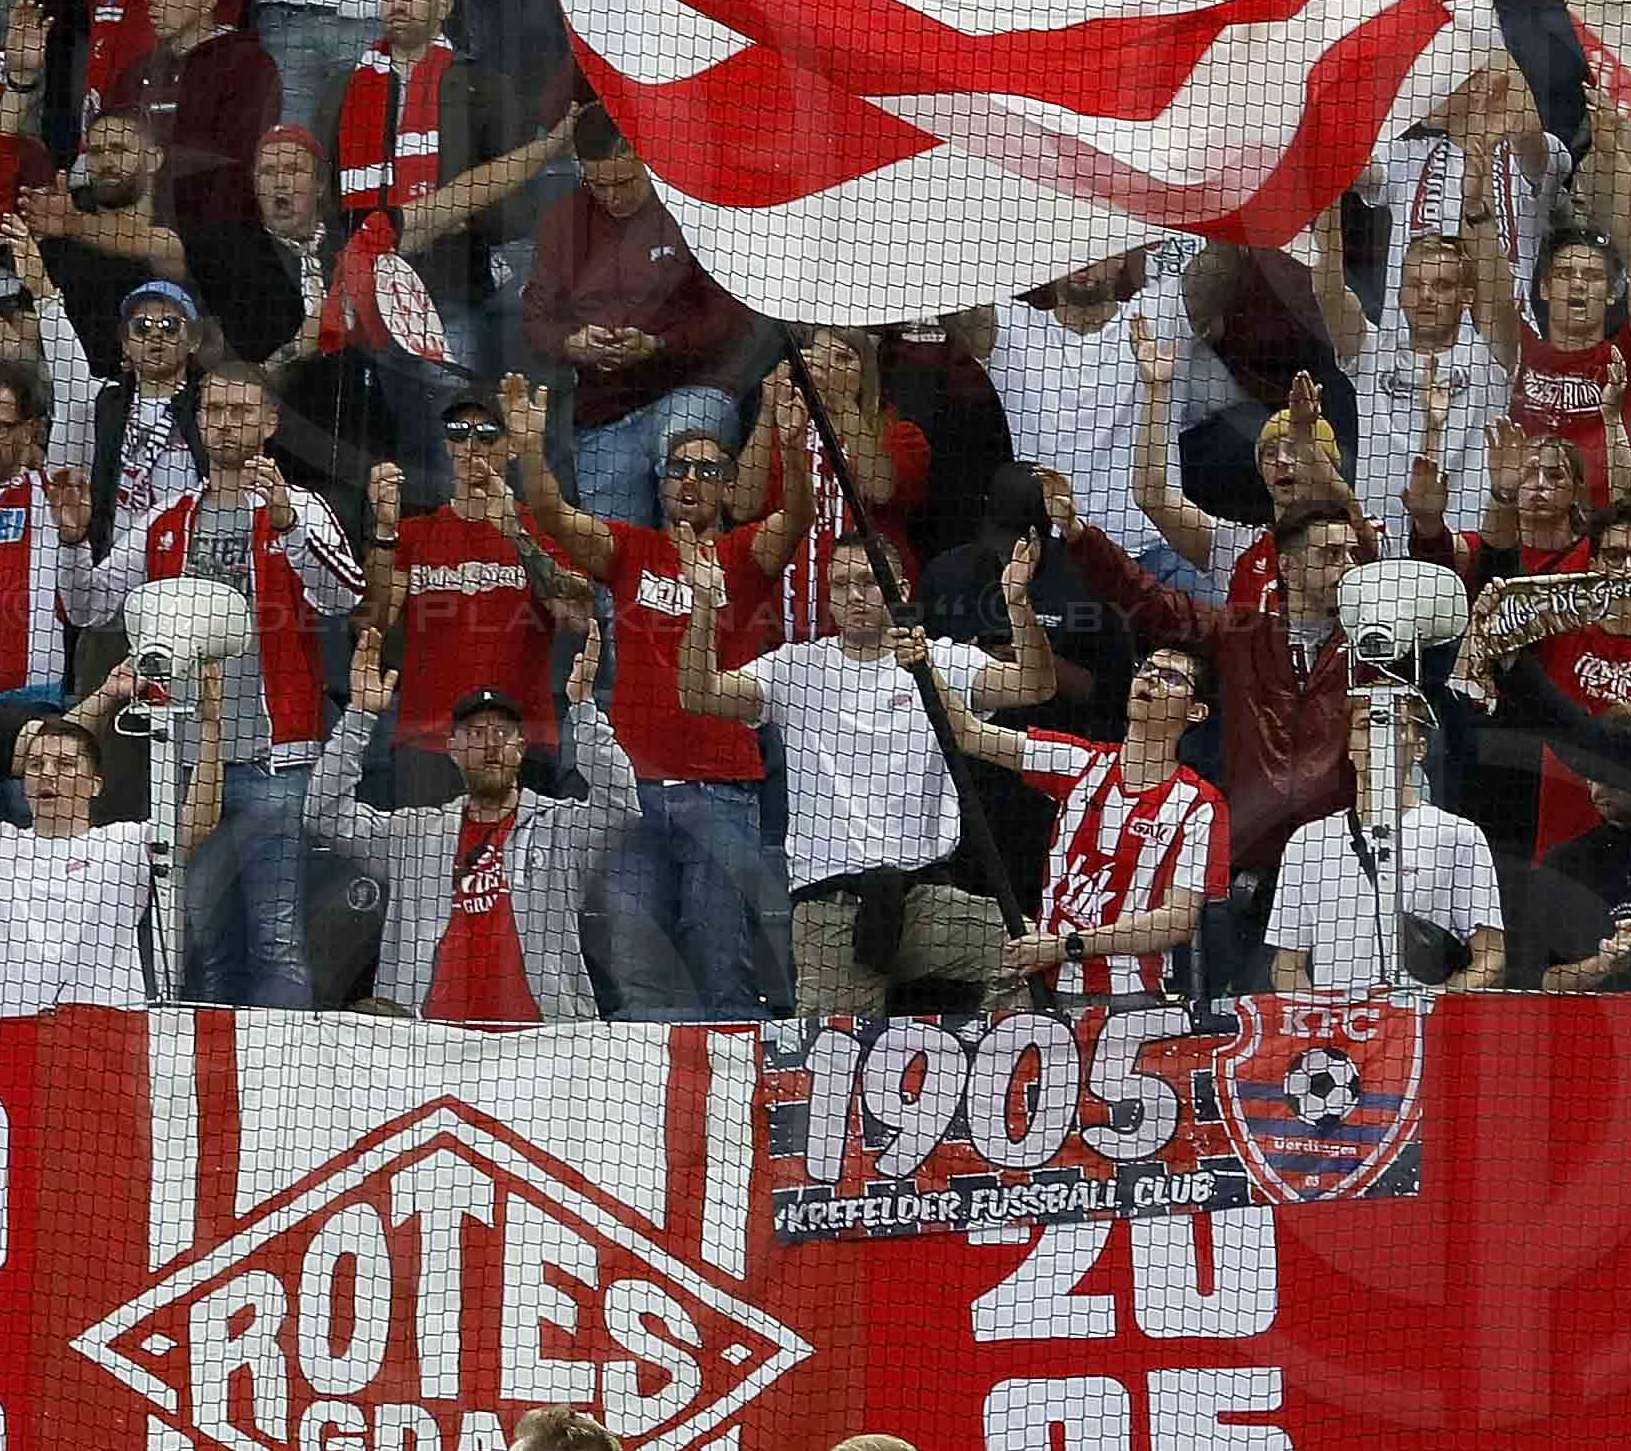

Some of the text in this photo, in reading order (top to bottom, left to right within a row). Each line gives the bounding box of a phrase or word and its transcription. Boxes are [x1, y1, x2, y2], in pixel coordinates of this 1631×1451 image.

[1280, 1006, 1380, 1041] KFC
[805, 1005, 1191, 1185] 1905
[781, 1172, 1217, 1236] KREFELDER FUSSBALL CLUB
[188, 1146, 705, 1440] ROTES
